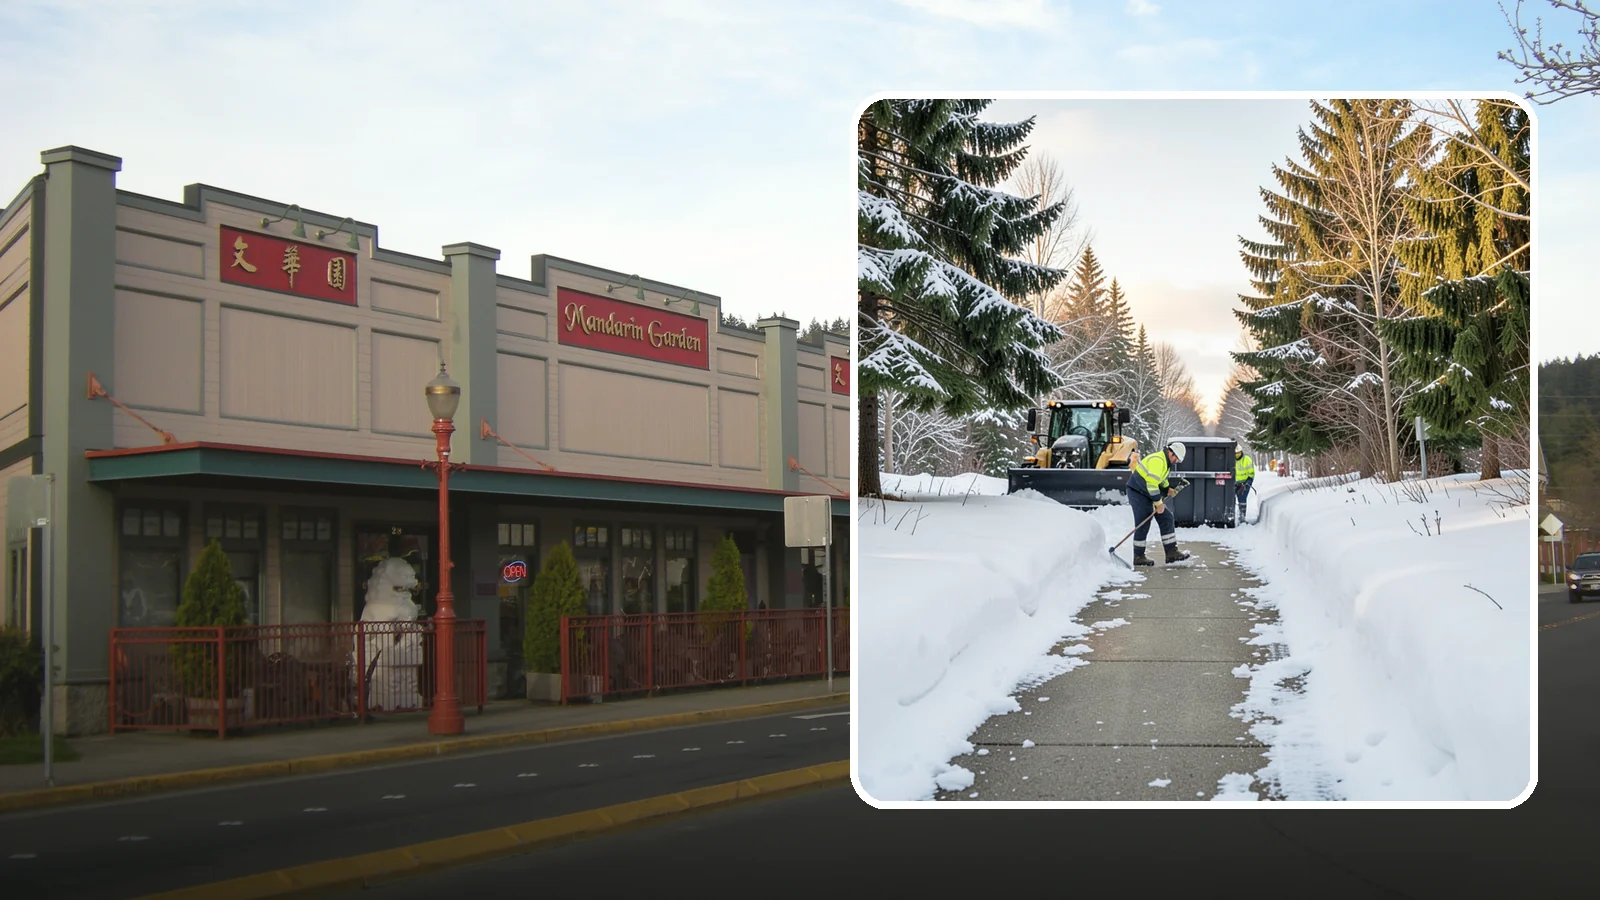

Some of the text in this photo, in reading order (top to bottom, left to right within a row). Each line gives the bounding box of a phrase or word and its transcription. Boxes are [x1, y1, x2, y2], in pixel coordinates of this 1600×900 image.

[564, 301, 702, 352] Mandarin Garden
[503, 565, 527, 578] OPEN
